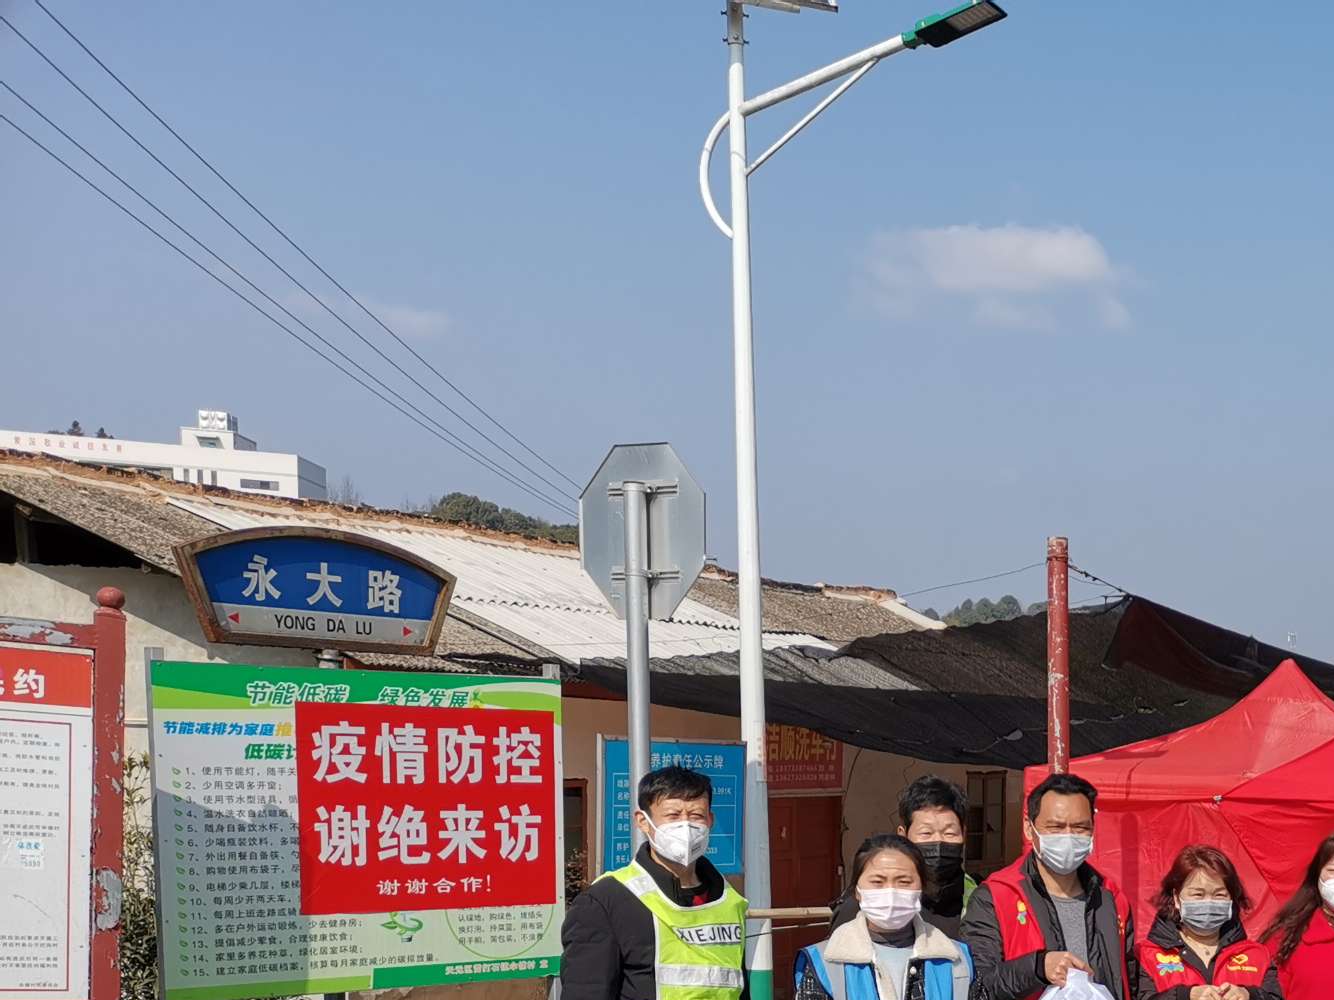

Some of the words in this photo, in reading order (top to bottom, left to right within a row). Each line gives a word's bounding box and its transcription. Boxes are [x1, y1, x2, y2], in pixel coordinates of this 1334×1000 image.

[242, 554, 402, 614] 永大路
[274, 614, 316, 632] YONG
[327, 618, 346, 634] DA
[356, 620, 373, 636] LU
[248, 681, 349, 706] 节能低碳
[378, 687, 472, 709] 绿色发展
[311, 721, 543, 785] 疫情防控
[313, 803, 542, 866] 谢绝来访
